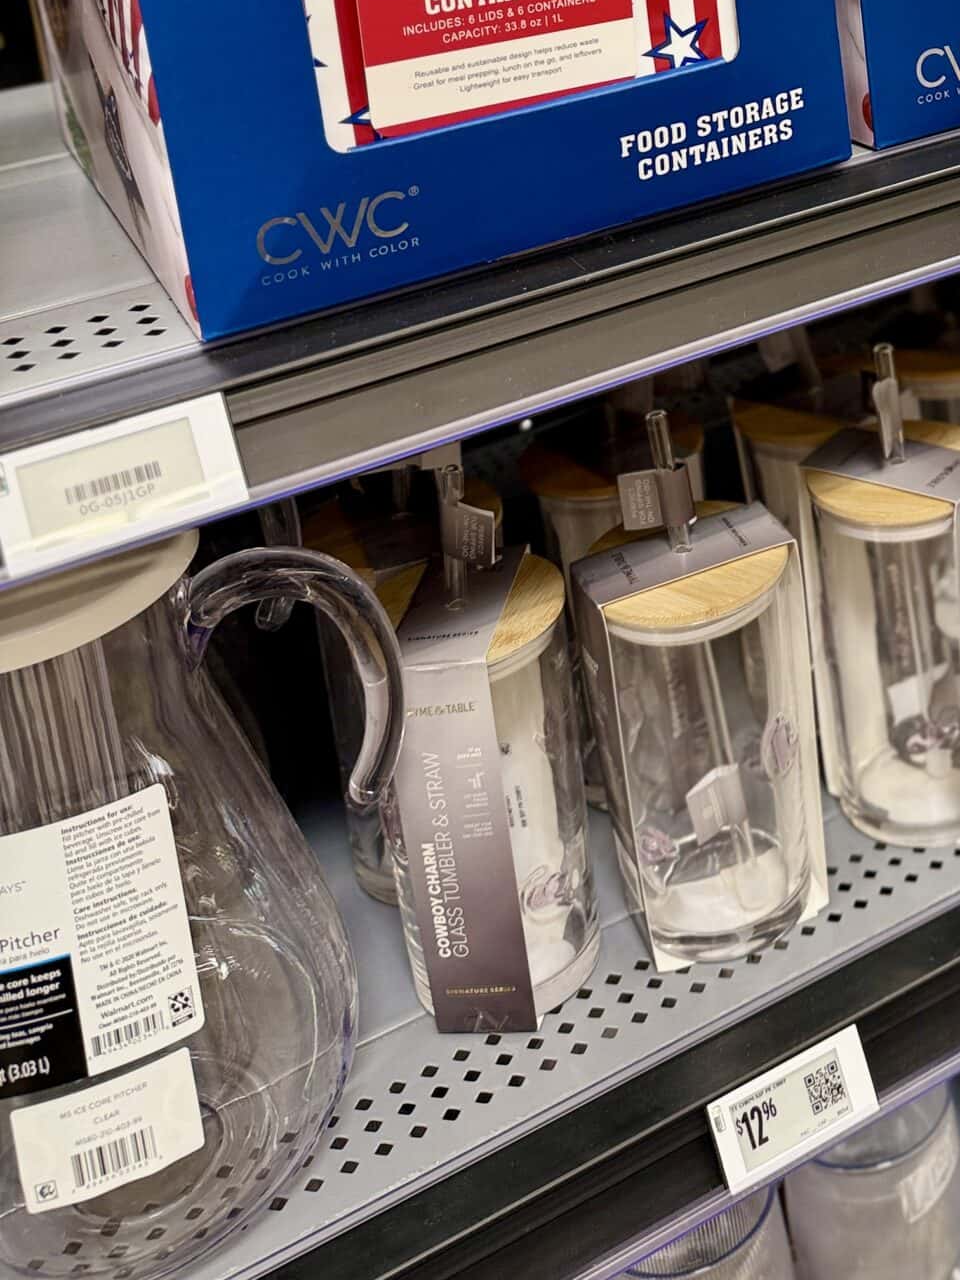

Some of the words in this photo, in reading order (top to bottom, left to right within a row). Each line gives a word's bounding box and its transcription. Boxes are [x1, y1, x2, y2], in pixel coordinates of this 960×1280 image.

[403, 18, 465, 36] INCLUDES:
[468, 14, 475, 25] 6
[478, 10, 504, 23] LIDS
[507, 8, 515, 18] &
[517, 6, 524, 16] 6
[442, 26, 501, 44] CAPACITY:
[505, 20, 527, 33] 33.8
[530, 18, 542, 28] oz
[552, 14, 564, 25] 1L
[413, 79, 435, 91] Great
[436, 77, 446, 87] for
[448, 73, 467, 84] meal
[502, 61, 522, 74] lunch
[524, 61, 533, 70] on
[534, 56, 546, 67] the
[559, 51, 573, 62] and
[574, 46, 602, 60] leftovers
[415, 65, 450, 78] Reusable
[452, 62, 465, 72] and
[467, 54, 507, 70] sustainable
[509, 50, 533, 63] design
[535, 46, 553, 58] helps
[554, 40, 577, 53] reduce
[579, 37, 599, 48] waste
[459, 78, 500, 93] Lightweight
[502, 76, 511, 86] for
[513, 72, 530, 85] easy
[531, 66, 562, 80] transport
[917, 89, 951, 105] COOK
[619, 123, 687, 159] FOOD
[696, 87, 805, 139] STORAGE
[637, 117, 794, 181] CONTAINERS
[261, 265, 311, 287] COOK
[320, 252, 361, 271] WITH
[369, 236, 421, 259] COLOR
[445, 701, 475, 713] TABLE
[422, 751, 447, 810] STRAW
[440, 815, 449, 828] &
[421, 843, 441, 893] CHARM
[435, 832, 460, 905] TUMBLER
[0, 927, 61, 953] Pitcher
[431, 894, 451, 958] COWBOY
[446, 906, 469, 957] GLASS
[6, 974, 29, 988] core
[31, 969, 62, 985] keeps
[26, 981, 60, 999] longer
[101, 994, 154, 1020] Walmart.com
[8, 1060, 38, 1083] (3.03
[39, 1056, 50, 1074] L)
